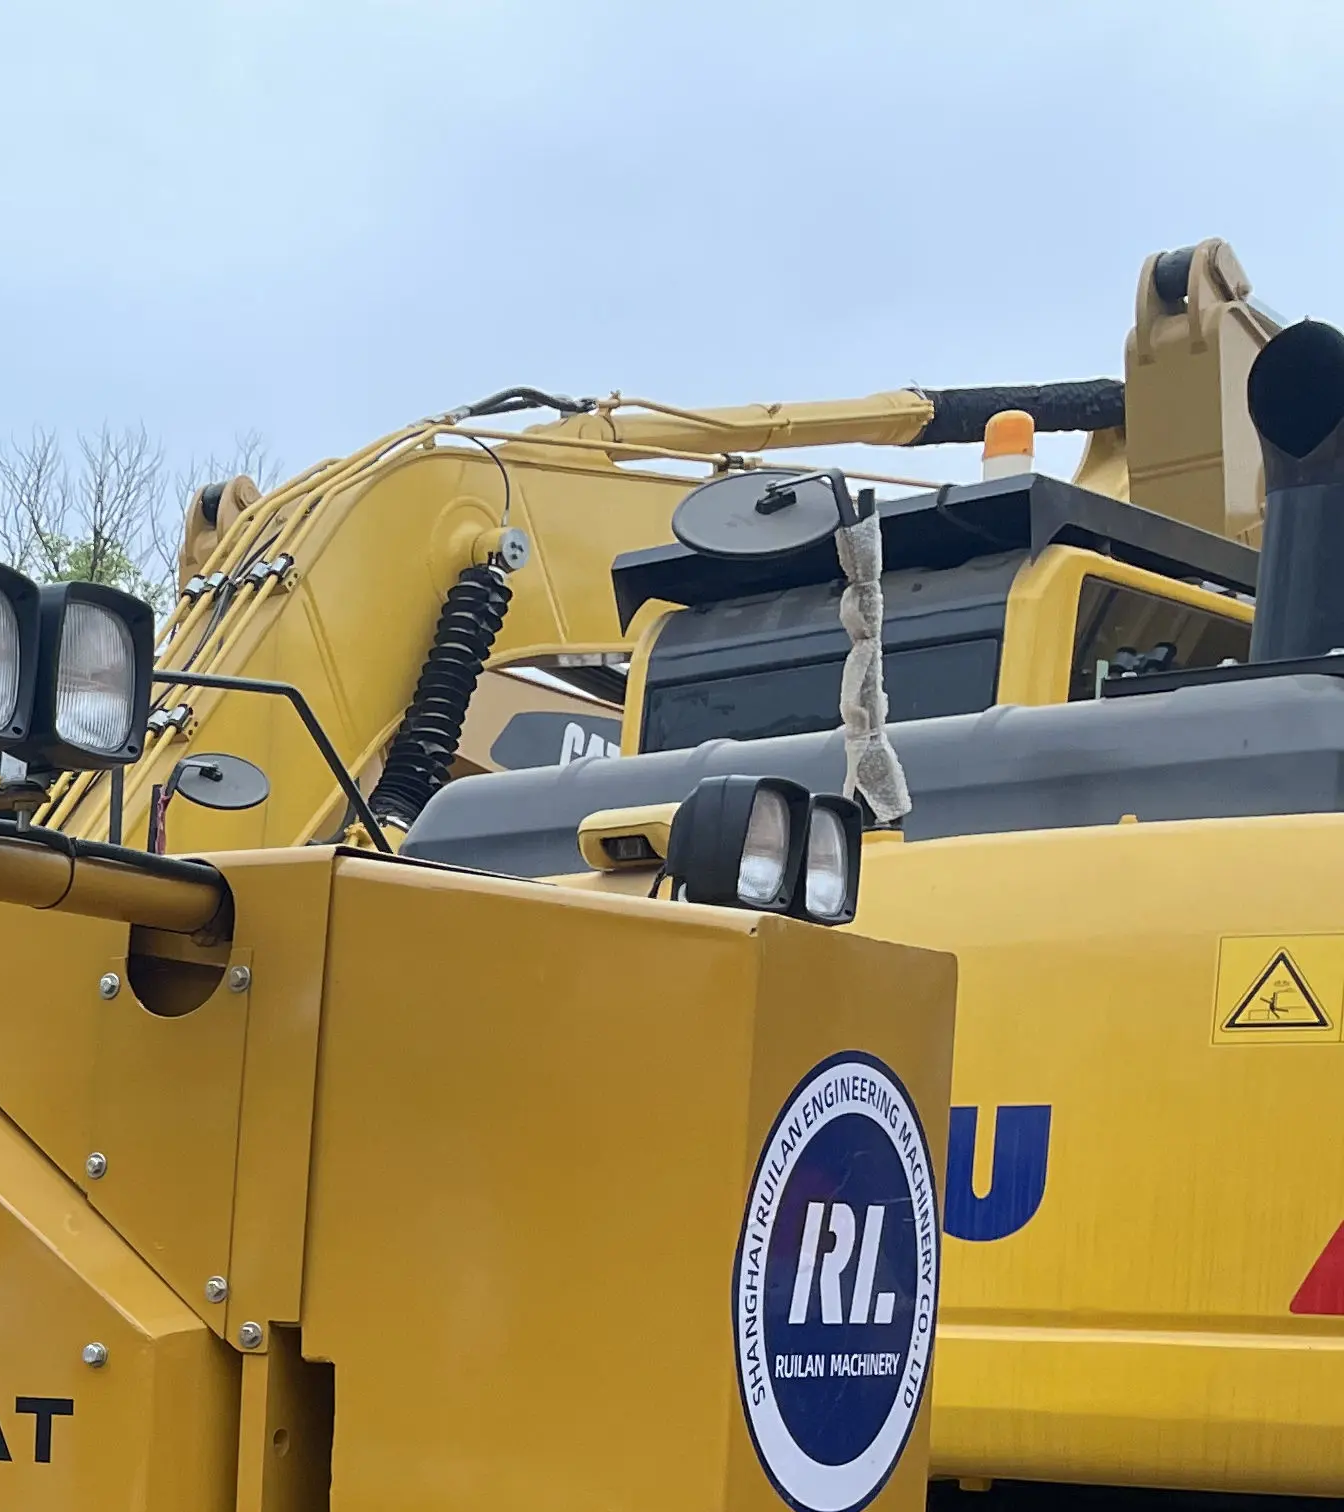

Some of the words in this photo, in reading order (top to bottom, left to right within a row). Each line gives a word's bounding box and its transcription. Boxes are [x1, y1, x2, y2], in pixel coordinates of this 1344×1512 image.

[802, 1075, 900, 1130] ENGINEERING
[757, 1117, 803, 1229] RUILAN
[898, 1121, 932, 1286] MACHINERY
[745, 1233, 766, 1406] SHANGHAI
[775, 1354, 825, 1379] RUILAN
[830, 1352, 900, 1377] MACHINERY
[903, 1359, 922, 1409] LTD
